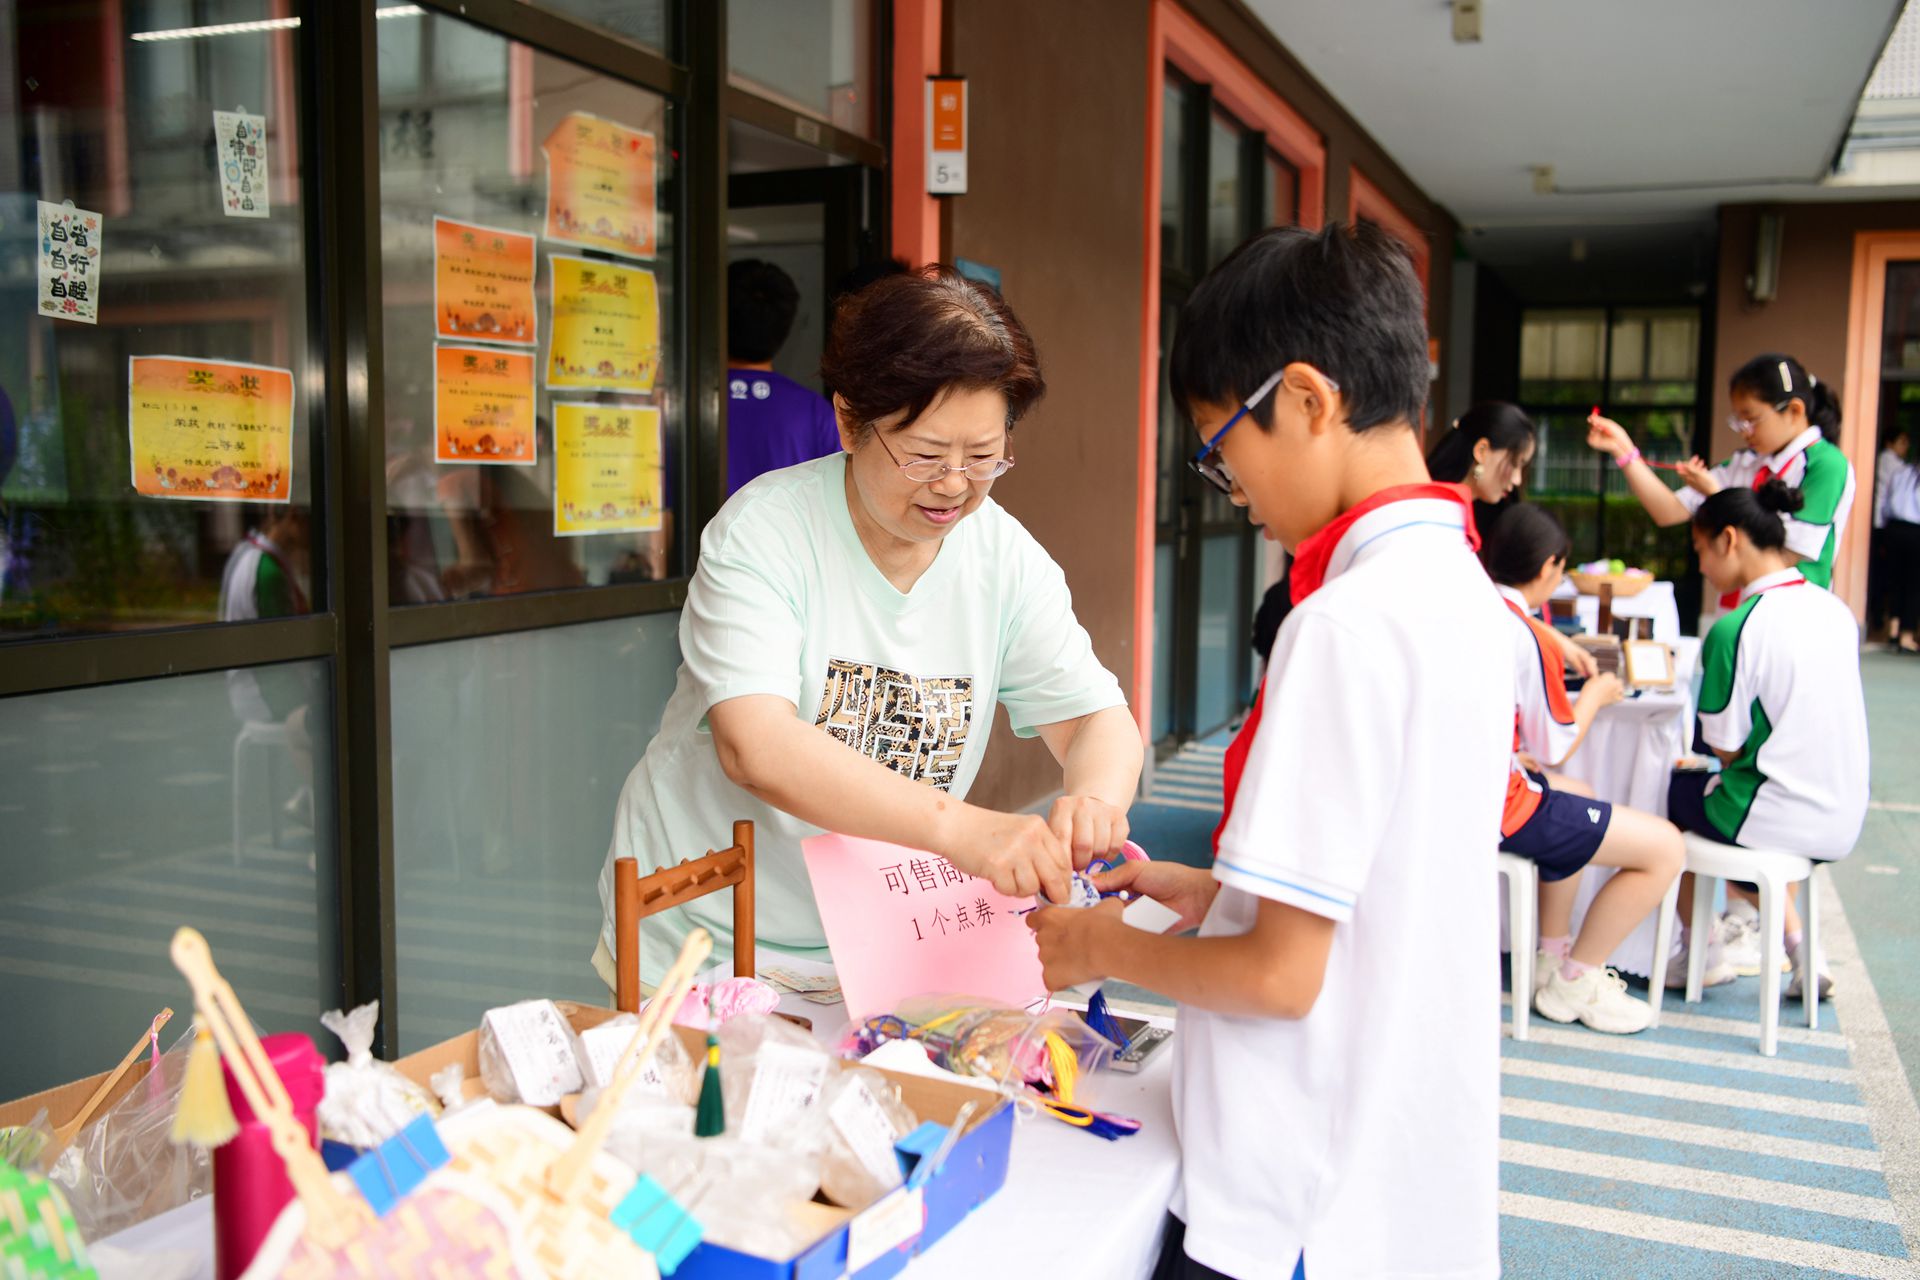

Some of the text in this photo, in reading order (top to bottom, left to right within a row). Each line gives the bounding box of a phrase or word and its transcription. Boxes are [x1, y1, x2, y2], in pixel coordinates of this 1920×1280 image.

[51, 220, 89, 248] 自省
[51, 248, 90, 275] 自行
[51, 276, 88, 302] 自醒
[879, 856, 978, 895] 可售商
